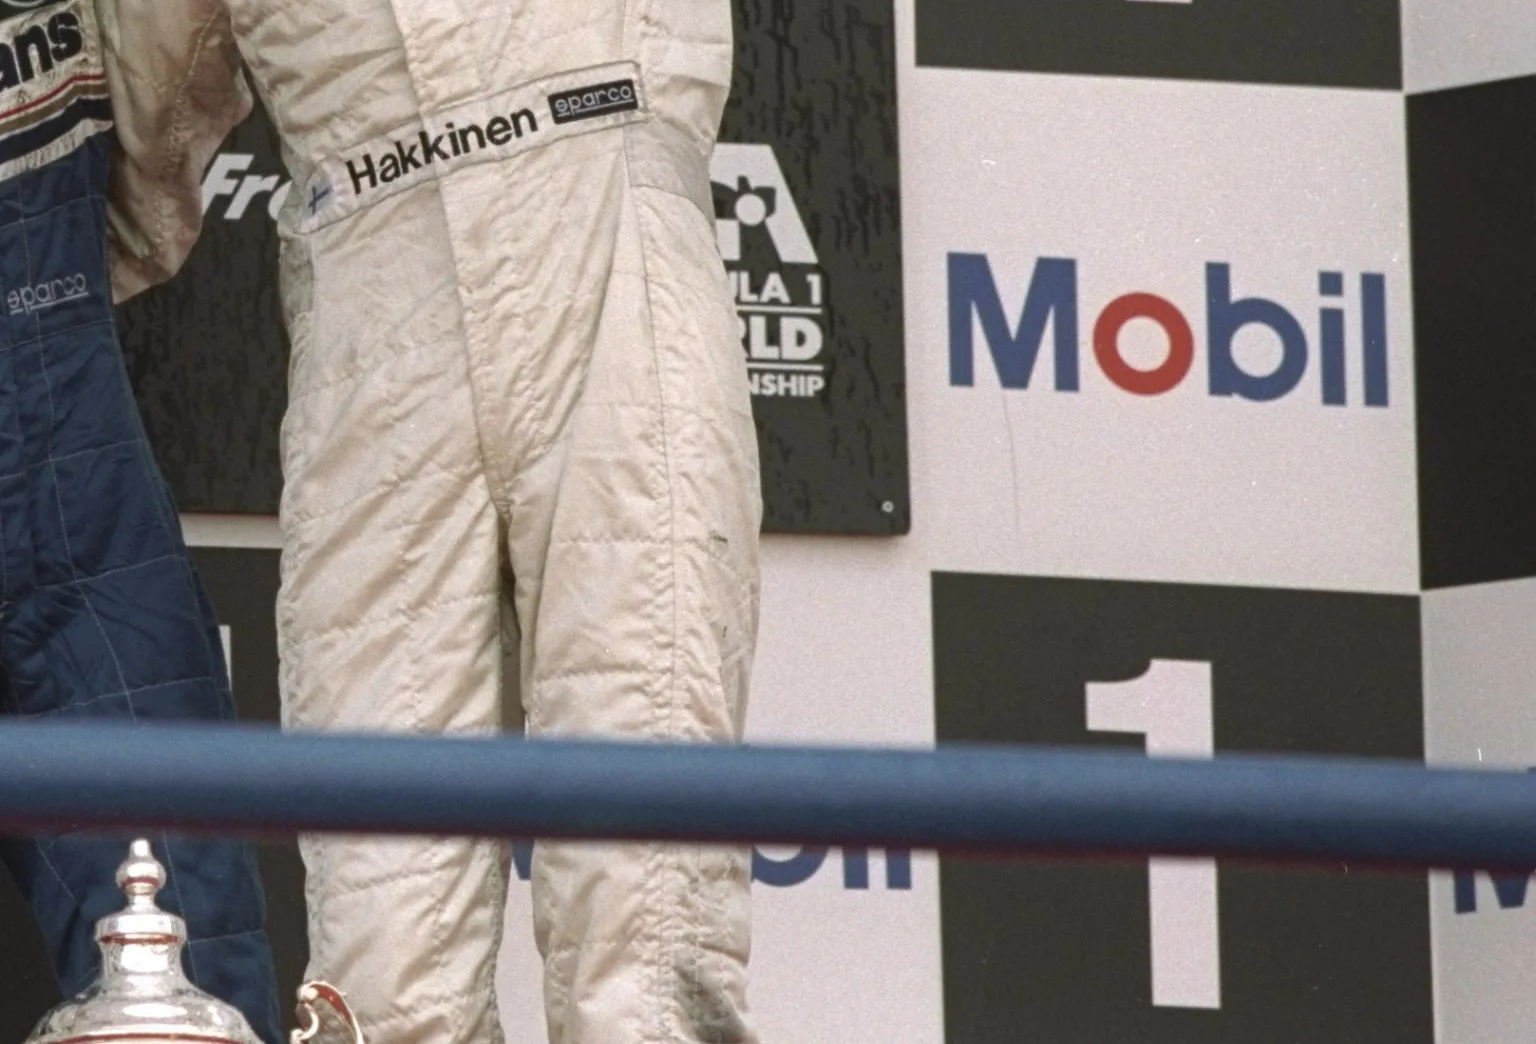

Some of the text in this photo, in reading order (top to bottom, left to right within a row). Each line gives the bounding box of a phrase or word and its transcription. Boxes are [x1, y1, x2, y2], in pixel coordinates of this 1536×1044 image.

[345, 106, 538, 195] Hakkinen
[947, 251, 1389, 408] Mobil
[1085, 658, 1221, 1009] 1
